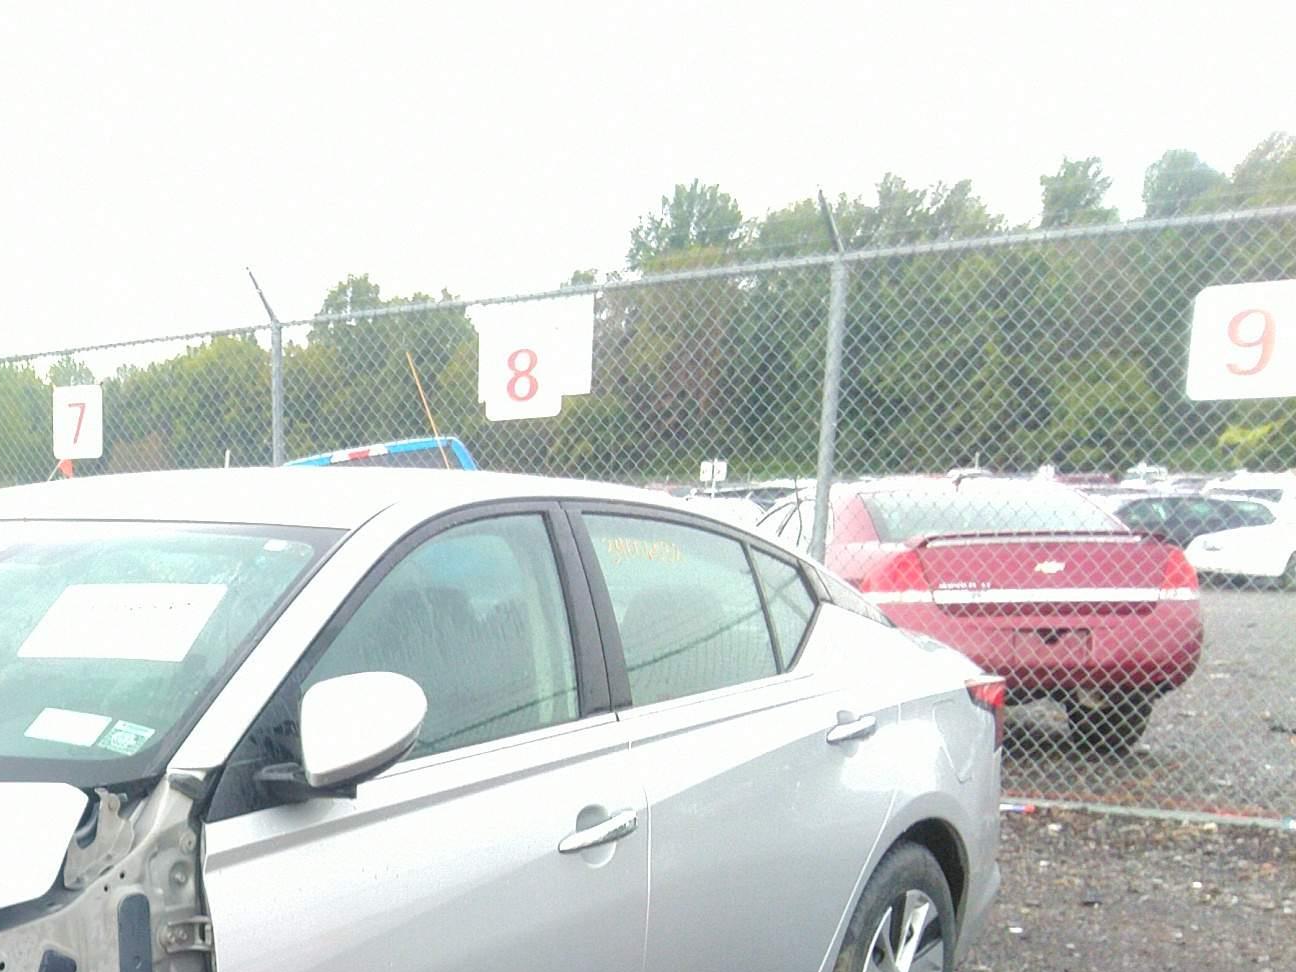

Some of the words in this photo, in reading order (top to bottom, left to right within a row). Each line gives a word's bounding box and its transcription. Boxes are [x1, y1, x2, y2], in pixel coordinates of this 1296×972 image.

[1225, 308, 1276, 377] 9
[506, 348, 539, 402] 8
[67, 402, 86, 445] 7
